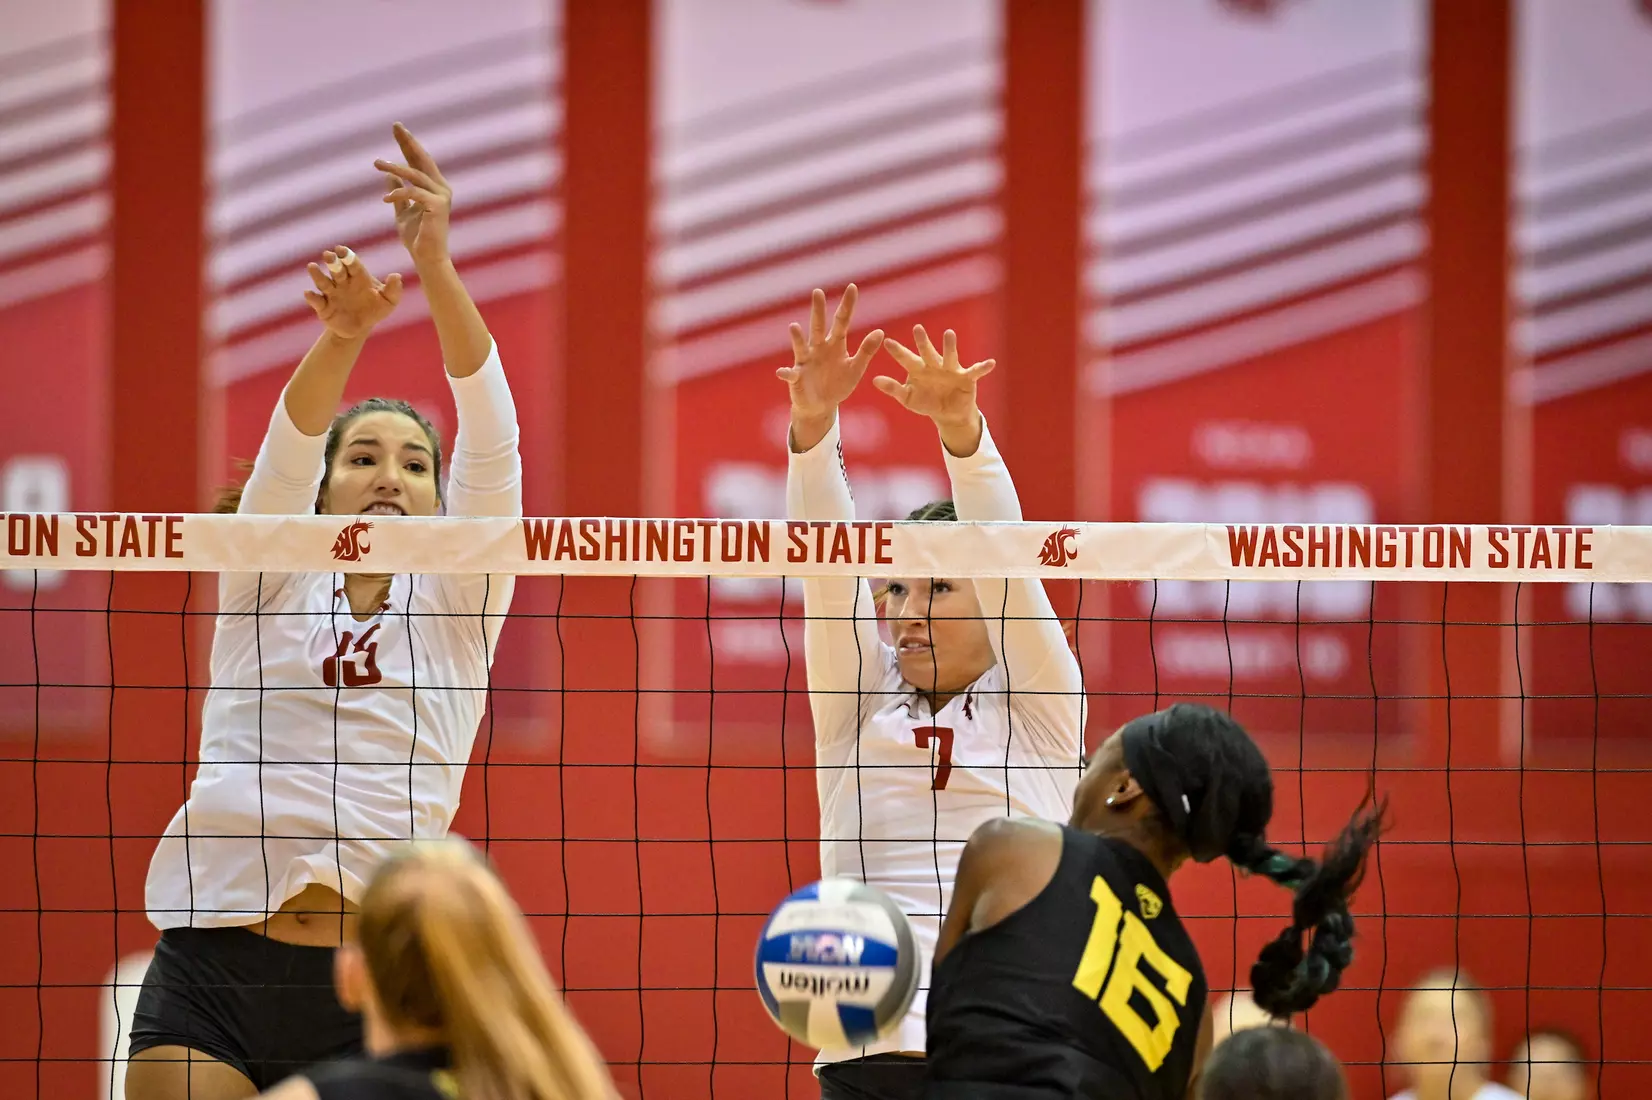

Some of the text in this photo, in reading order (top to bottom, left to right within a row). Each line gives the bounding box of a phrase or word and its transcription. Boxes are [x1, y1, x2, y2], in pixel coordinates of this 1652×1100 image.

[75, 515, 184, 559] STATE
[523, 518, 893, 564] WASHINGTON STATE
[1227, 524, 1594, 570] WASHINGTON STATE
[912, 726, 954, 790] 7
[780, 971, 871, 998] molten
[1072, 874, 1193, 1073] 16
